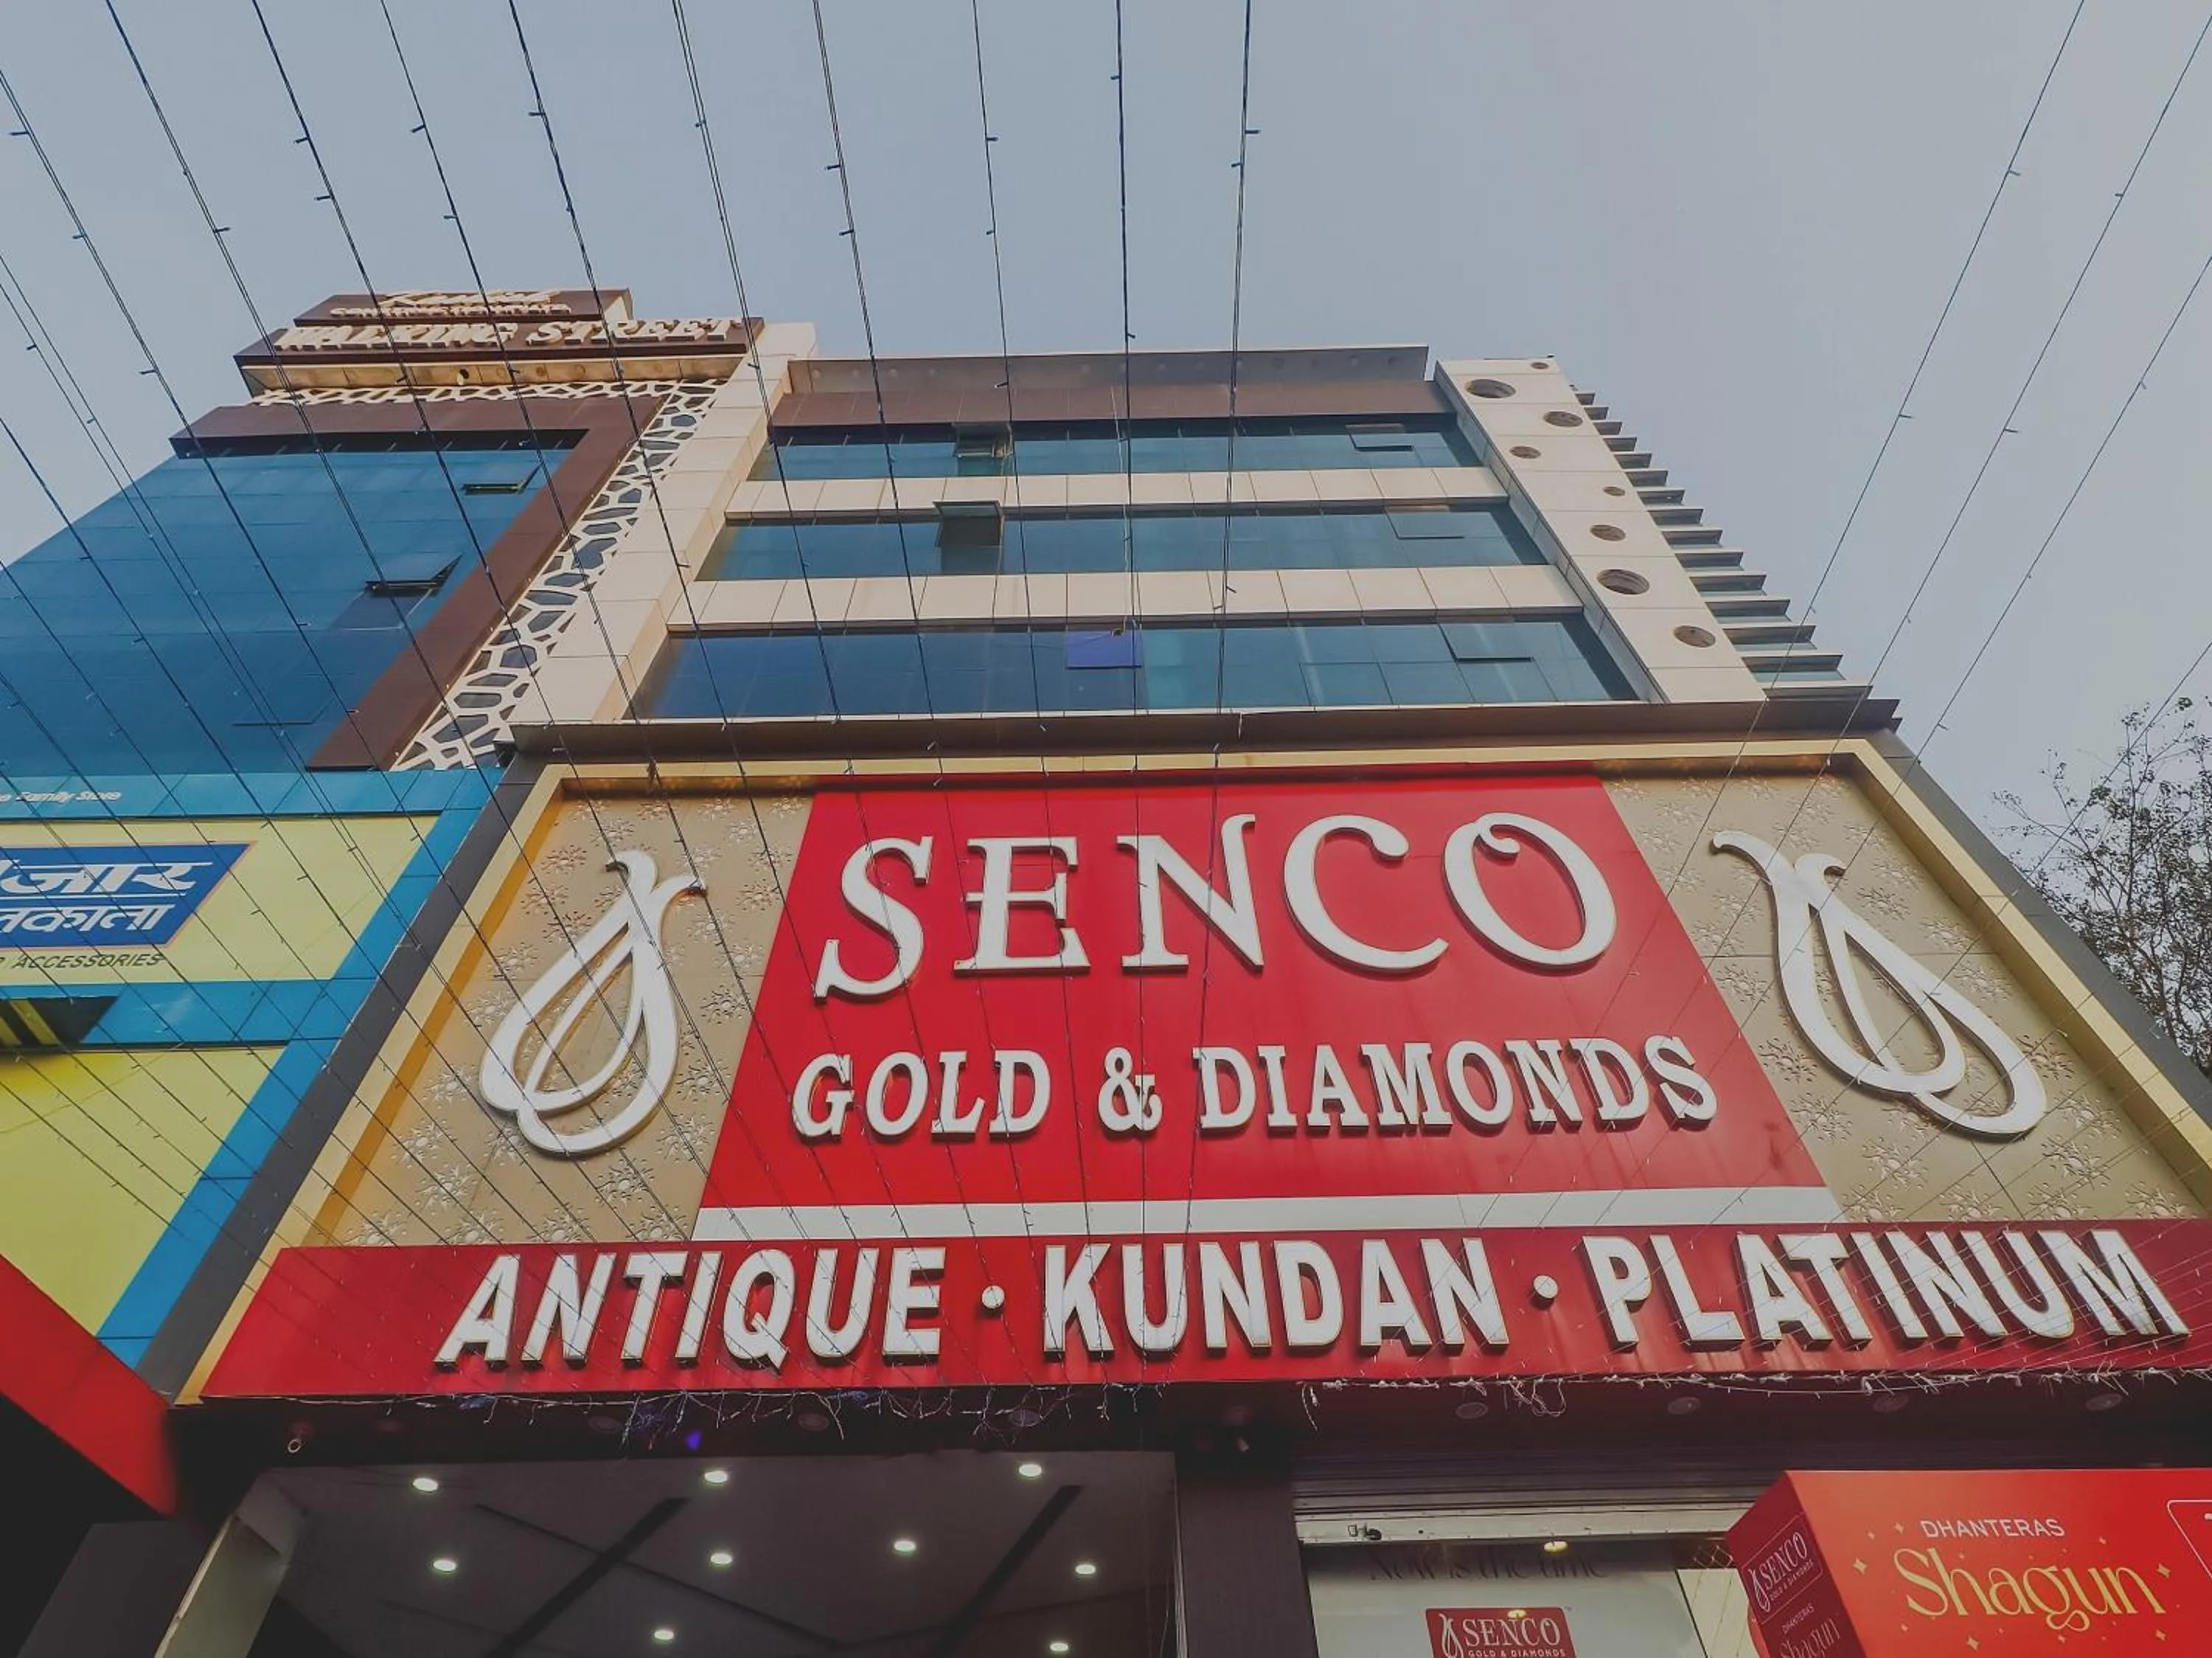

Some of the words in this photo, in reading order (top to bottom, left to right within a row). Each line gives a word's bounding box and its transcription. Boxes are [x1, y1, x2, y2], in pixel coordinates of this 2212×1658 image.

[273, 321, 518, 353] WALKING
[525, 318, 736, 346] STREET
[813, 811, 1618, 1003] SENCO
[12, 953, 165, 969] ACCESSORIES
[792, 1048, 1051, 1140] GOLD
[1097, 1046, 1163, 1134] &
[1193, 1033, 1718, 1134] DIAMONDS
[434, 1245, 947, 1376] ANTIQUE
[1043, 1238, 1510, 1361] KUNDAN
[1582, 1229, 2191, 1353] PLATINUM
[1921, 1518, 2065, 1539] DHANTERAS
[1759, 1532, 1807, 1592] SENCO
[1893, 1547, 2166, 1632] Shagun
[1462, 1617, 1562, 1647] SENCO
[1781, 1603, 1815, 1634] DHANTERAS
[1468, 1648, 1497, 1657] GOLD
[1511, 1648, 1566, 1657] DIAMONDS
